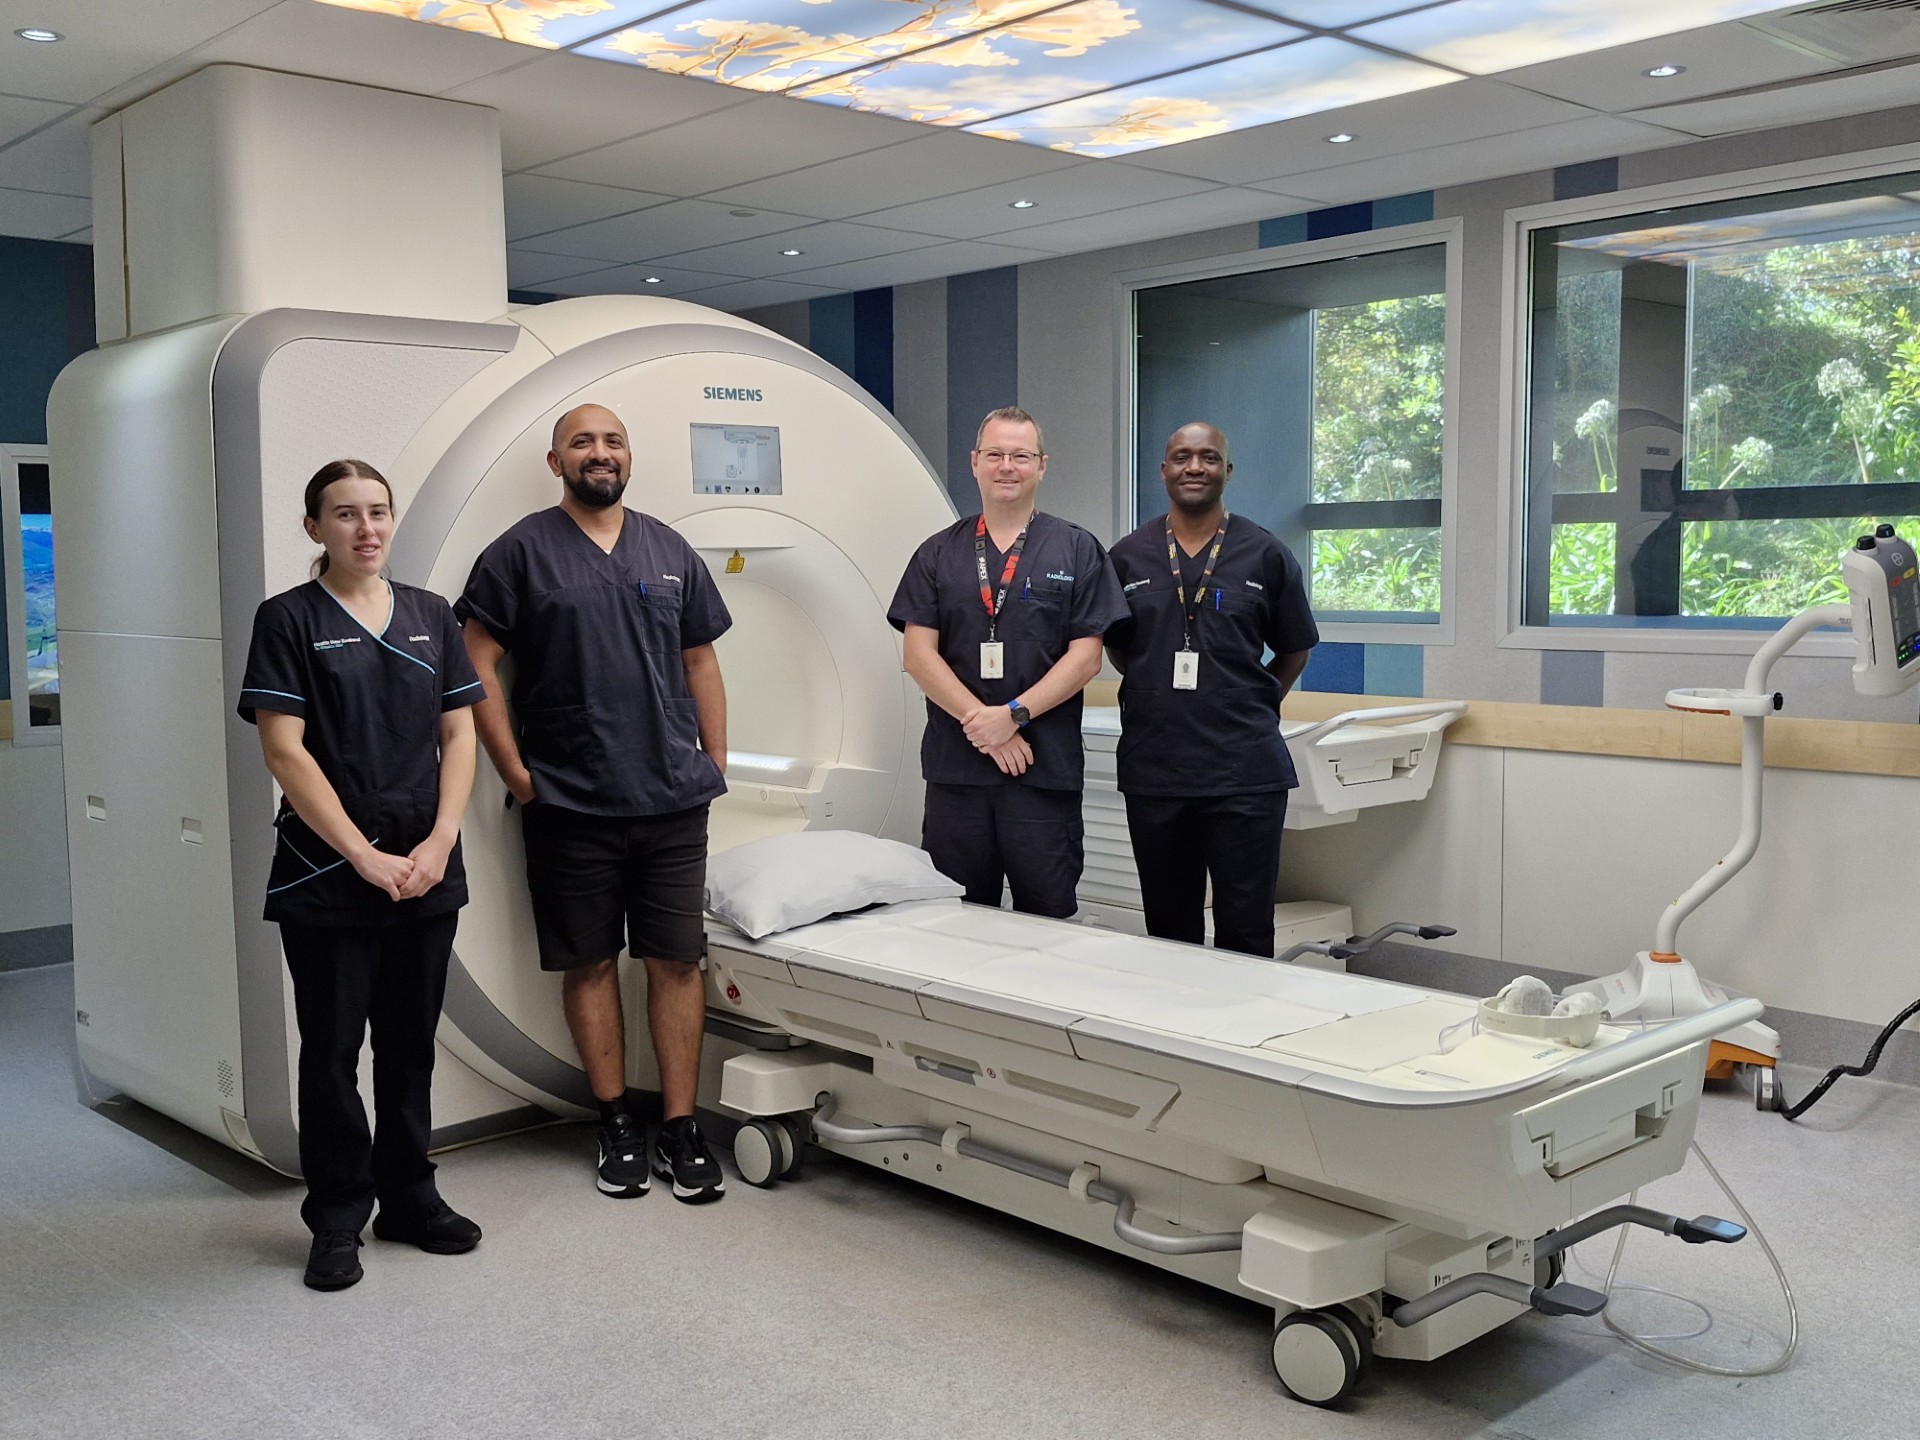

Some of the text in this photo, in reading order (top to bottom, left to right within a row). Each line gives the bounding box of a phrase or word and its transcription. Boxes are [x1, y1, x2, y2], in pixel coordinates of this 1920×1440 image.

[703, 386, 763, 402] SIEMENS
[979, 562, 988, 580] APEX
[1046, 572, 1075, 582] RADIOLOGY
[995, 588, 1006, 609] APEX
